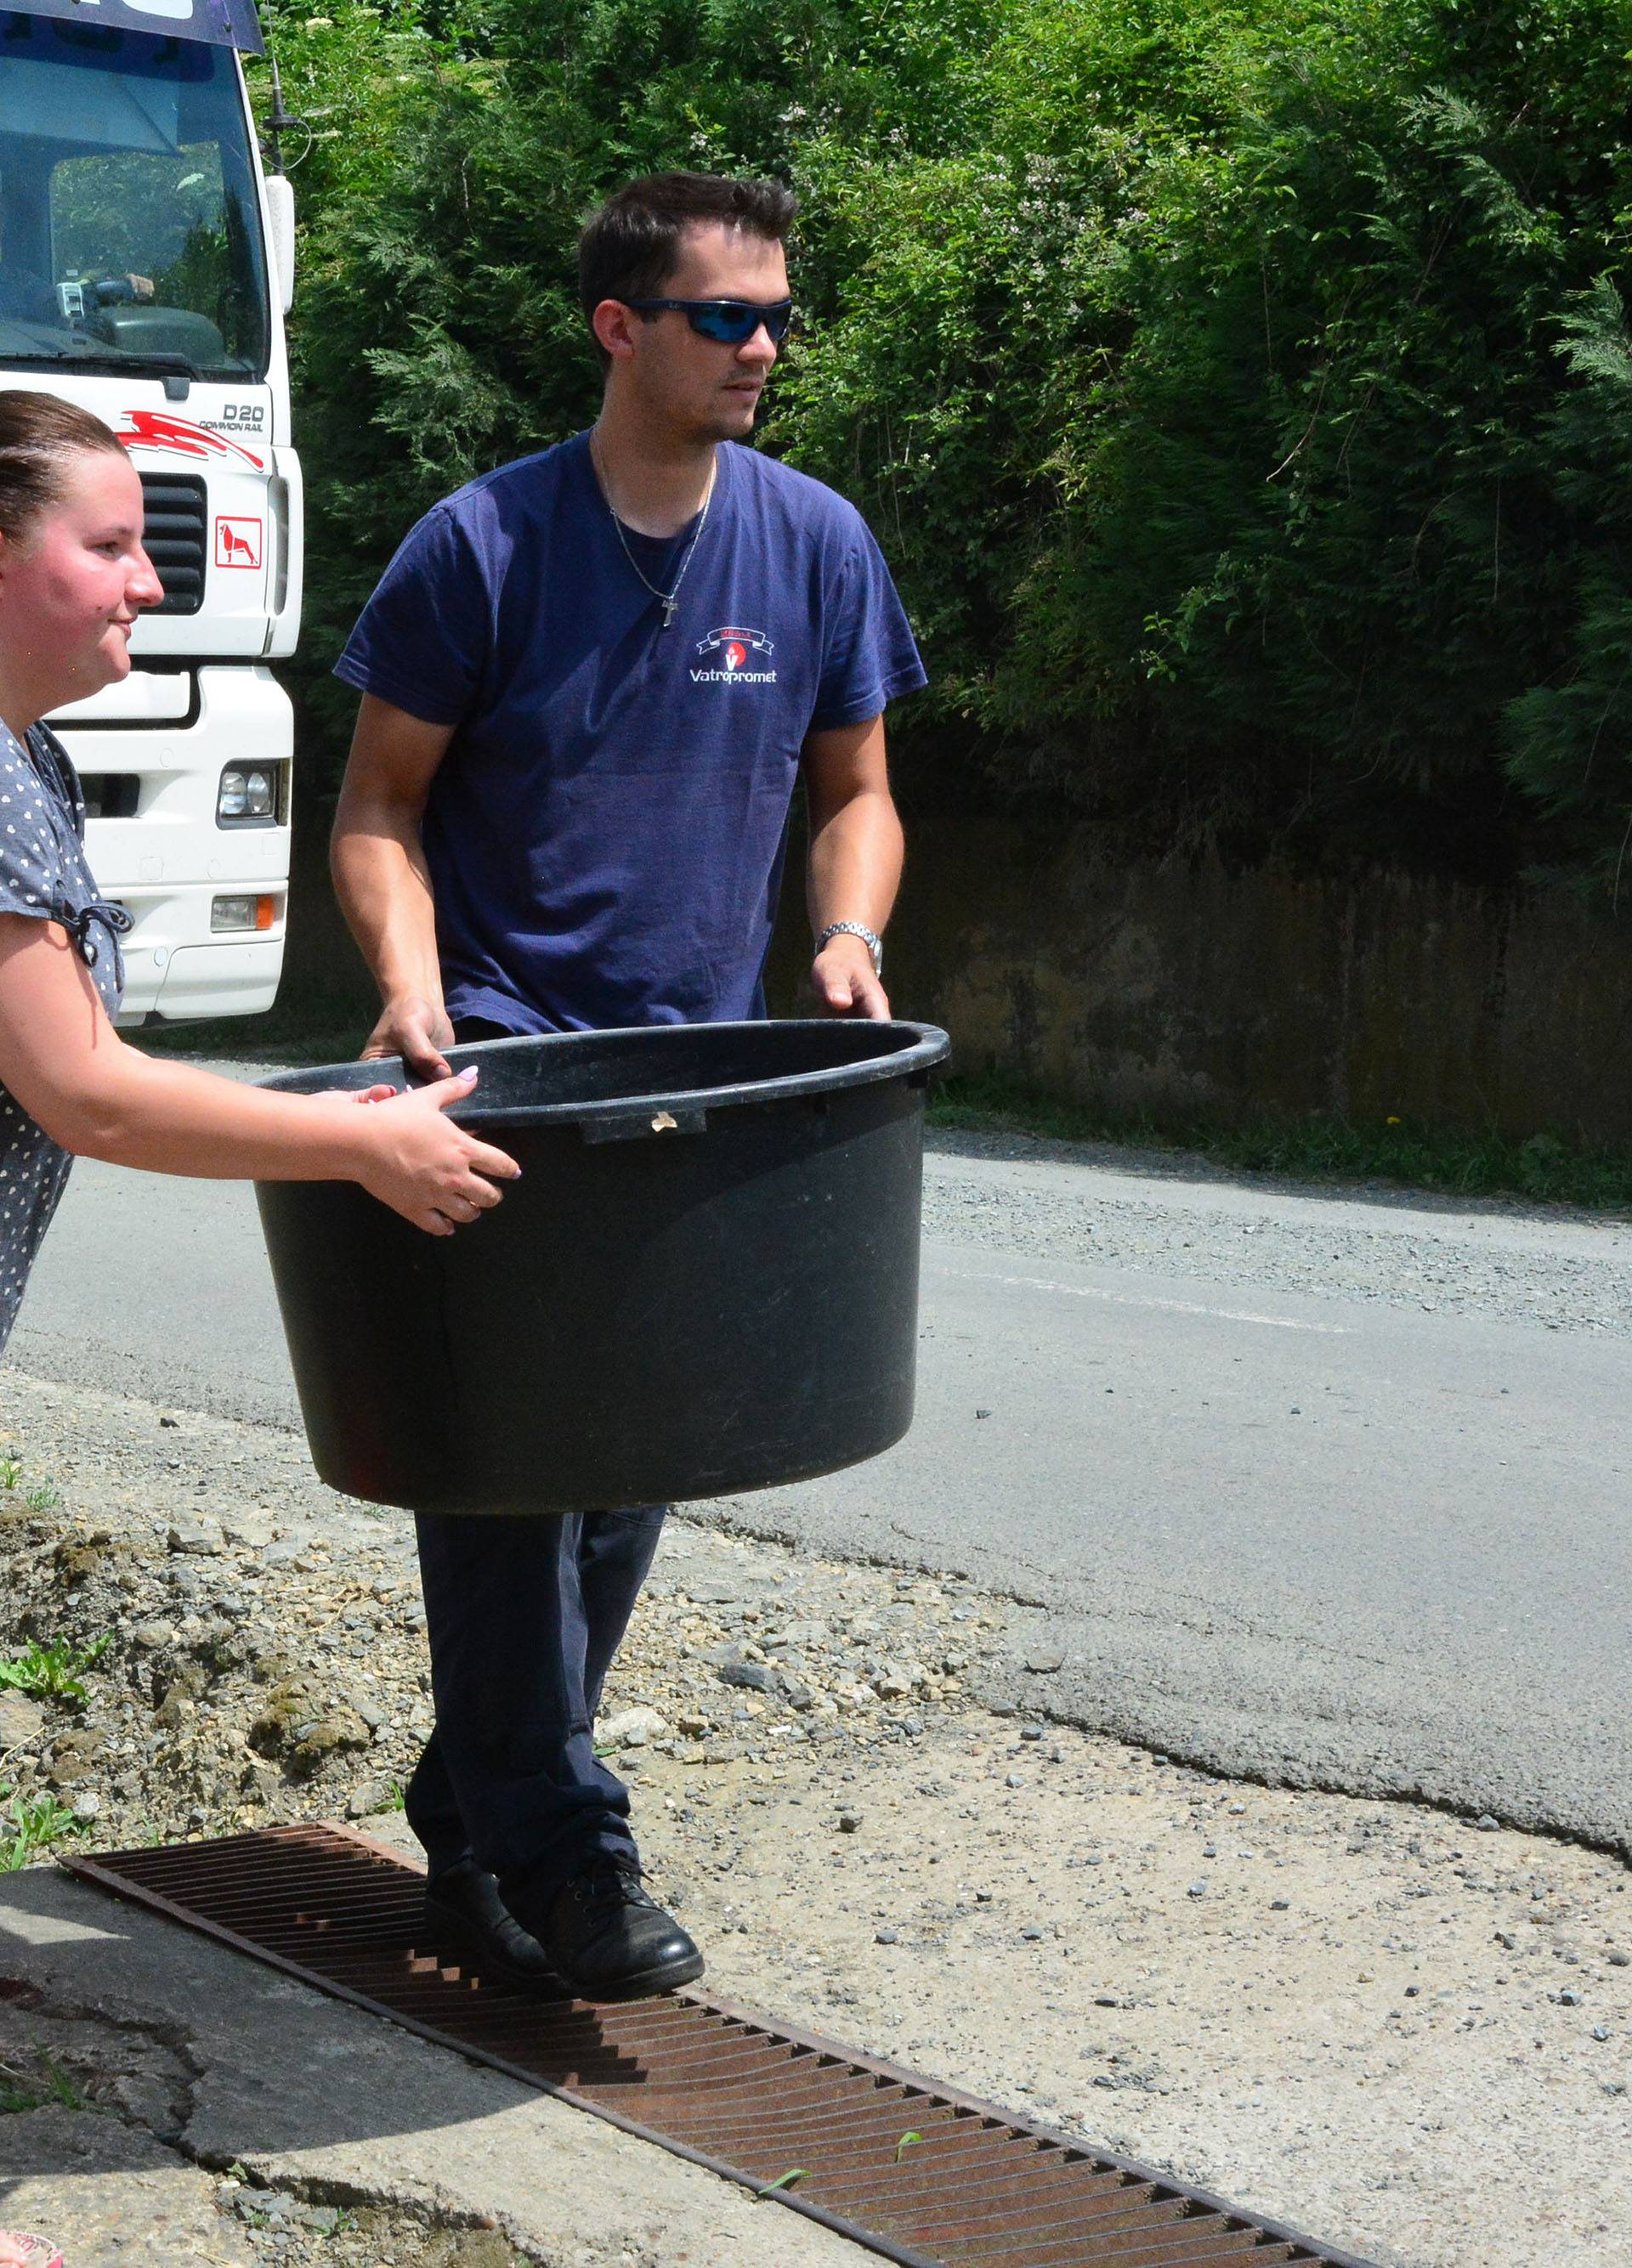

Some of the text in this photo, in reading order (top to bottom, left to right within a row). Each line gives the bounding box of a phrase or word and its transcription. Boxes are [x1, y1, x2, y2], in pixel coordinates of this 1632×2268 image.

[199, 421, 264, 433] COMMON RAIL
[689, 668, 777, 684] Vatropromet
